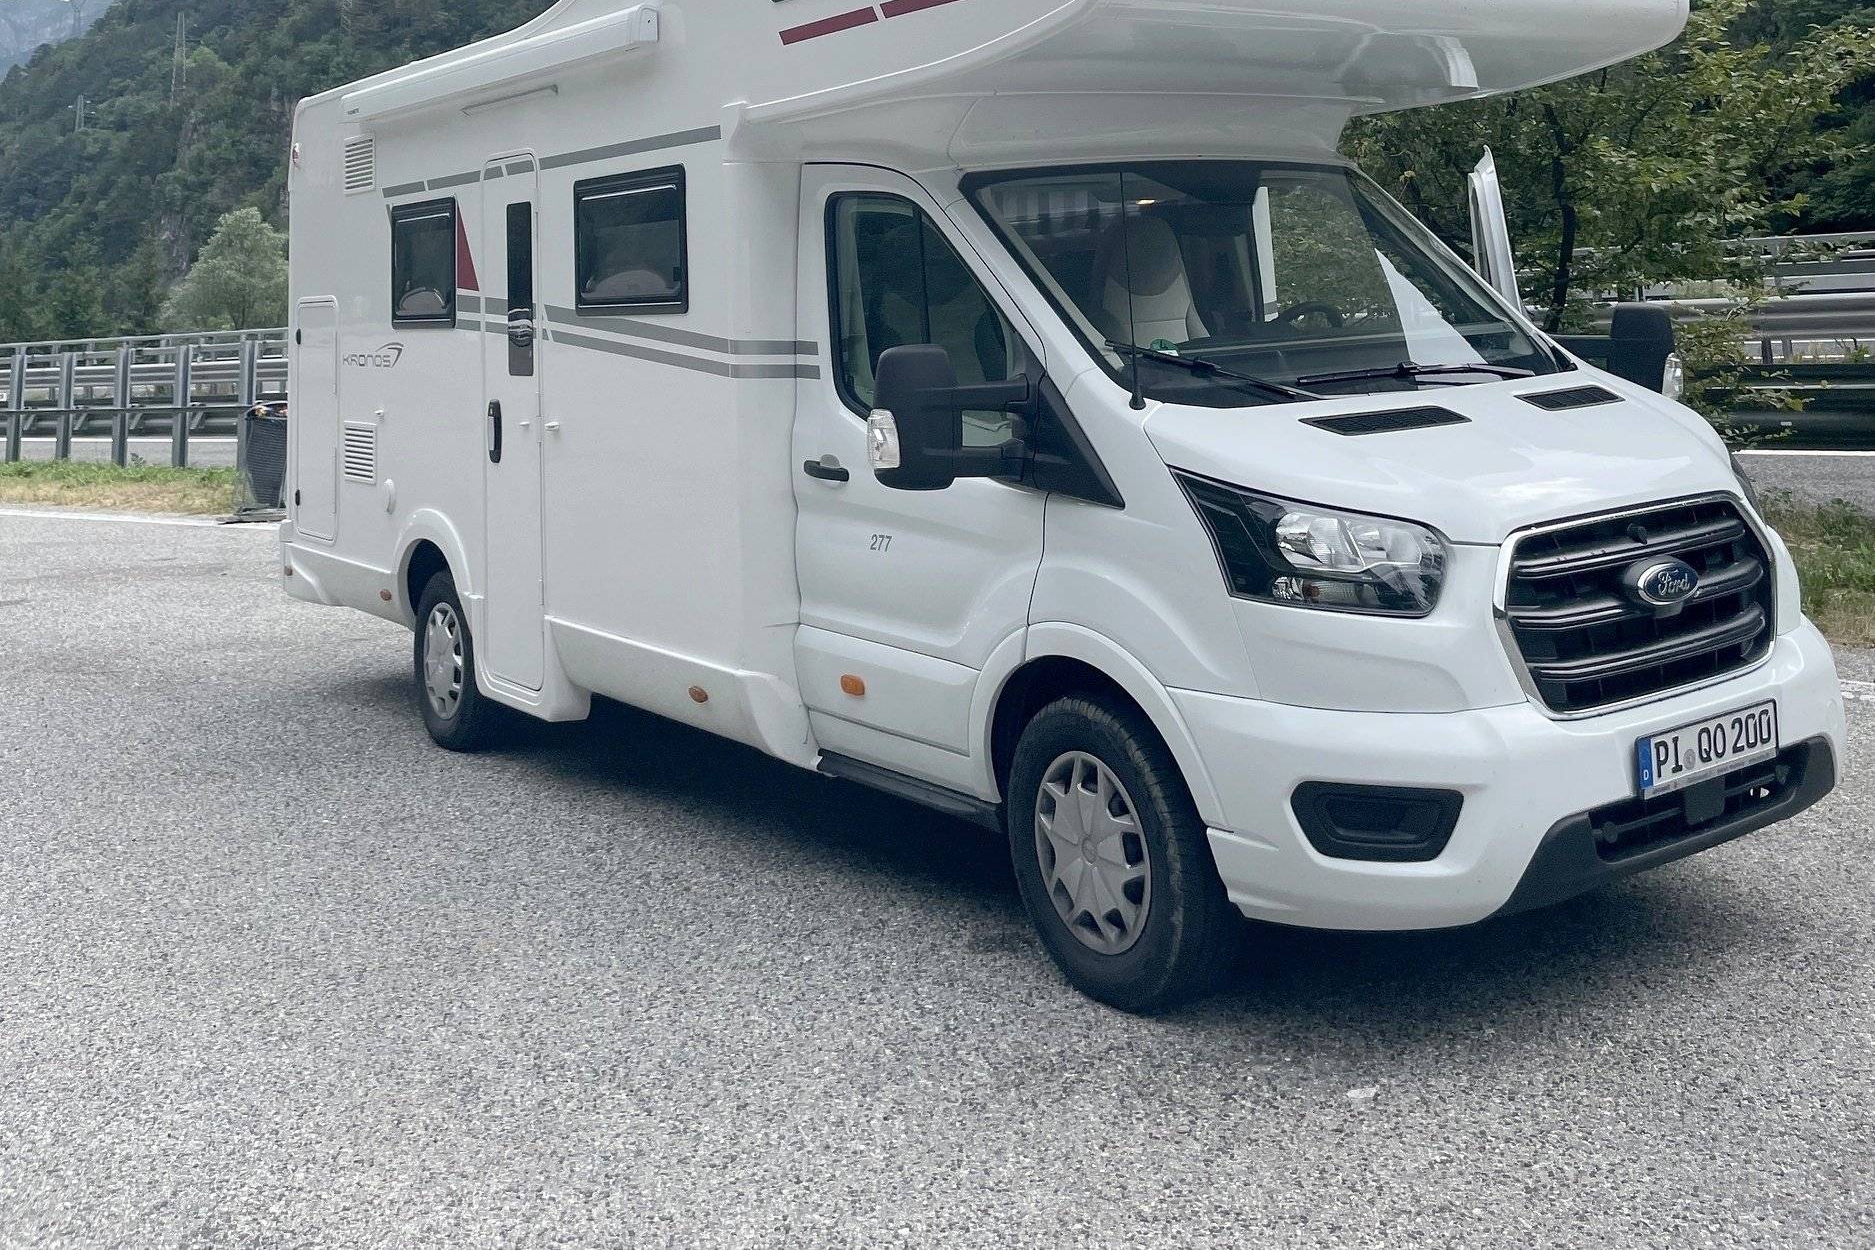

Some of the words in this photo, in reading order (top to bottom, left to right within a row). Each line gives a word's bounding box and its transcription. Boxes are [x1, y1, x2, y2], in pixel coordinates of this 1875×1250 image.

[870, 533, 892, 552] 277
[1657, 570, 1690, 596] Ford
[1654, 735, 1683, 778] PI
[1731, 708, 1771, 754] 200
[1643, 769, 1650, 781] D
